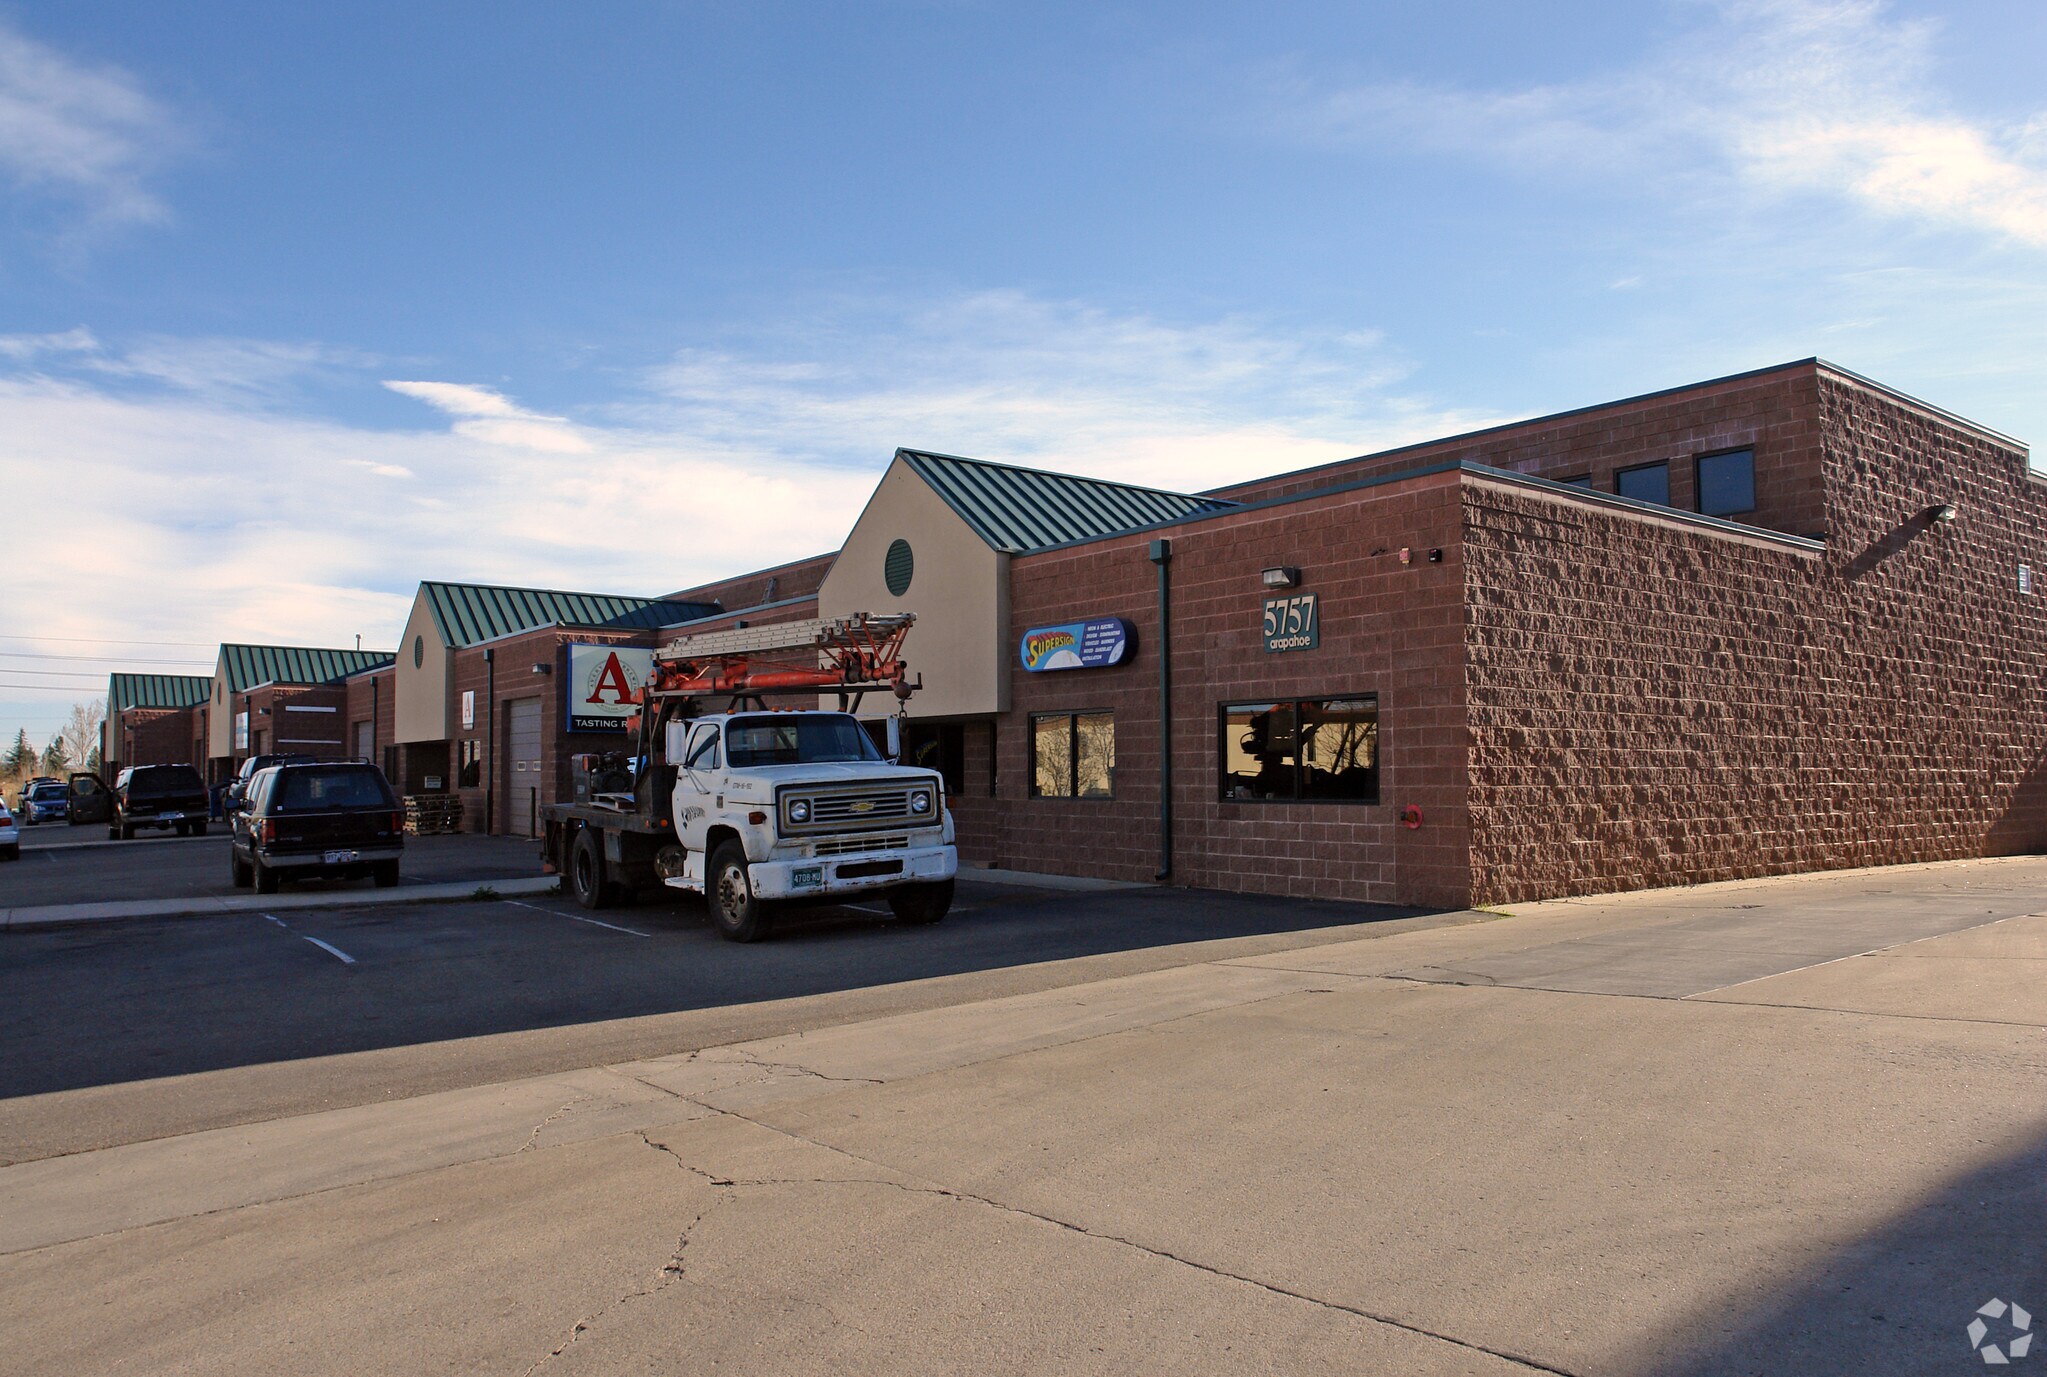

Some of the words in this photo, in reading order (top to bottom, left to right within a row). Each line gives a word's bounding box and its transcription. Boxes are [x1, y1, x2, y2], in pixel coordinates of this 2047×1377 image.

[1264, 595, 1314, 636] 5757
[1270, 635, 1310, 650] arapahoe
[585, 651, 643, 704] A
[574, 719, 618, 728] TASTING
